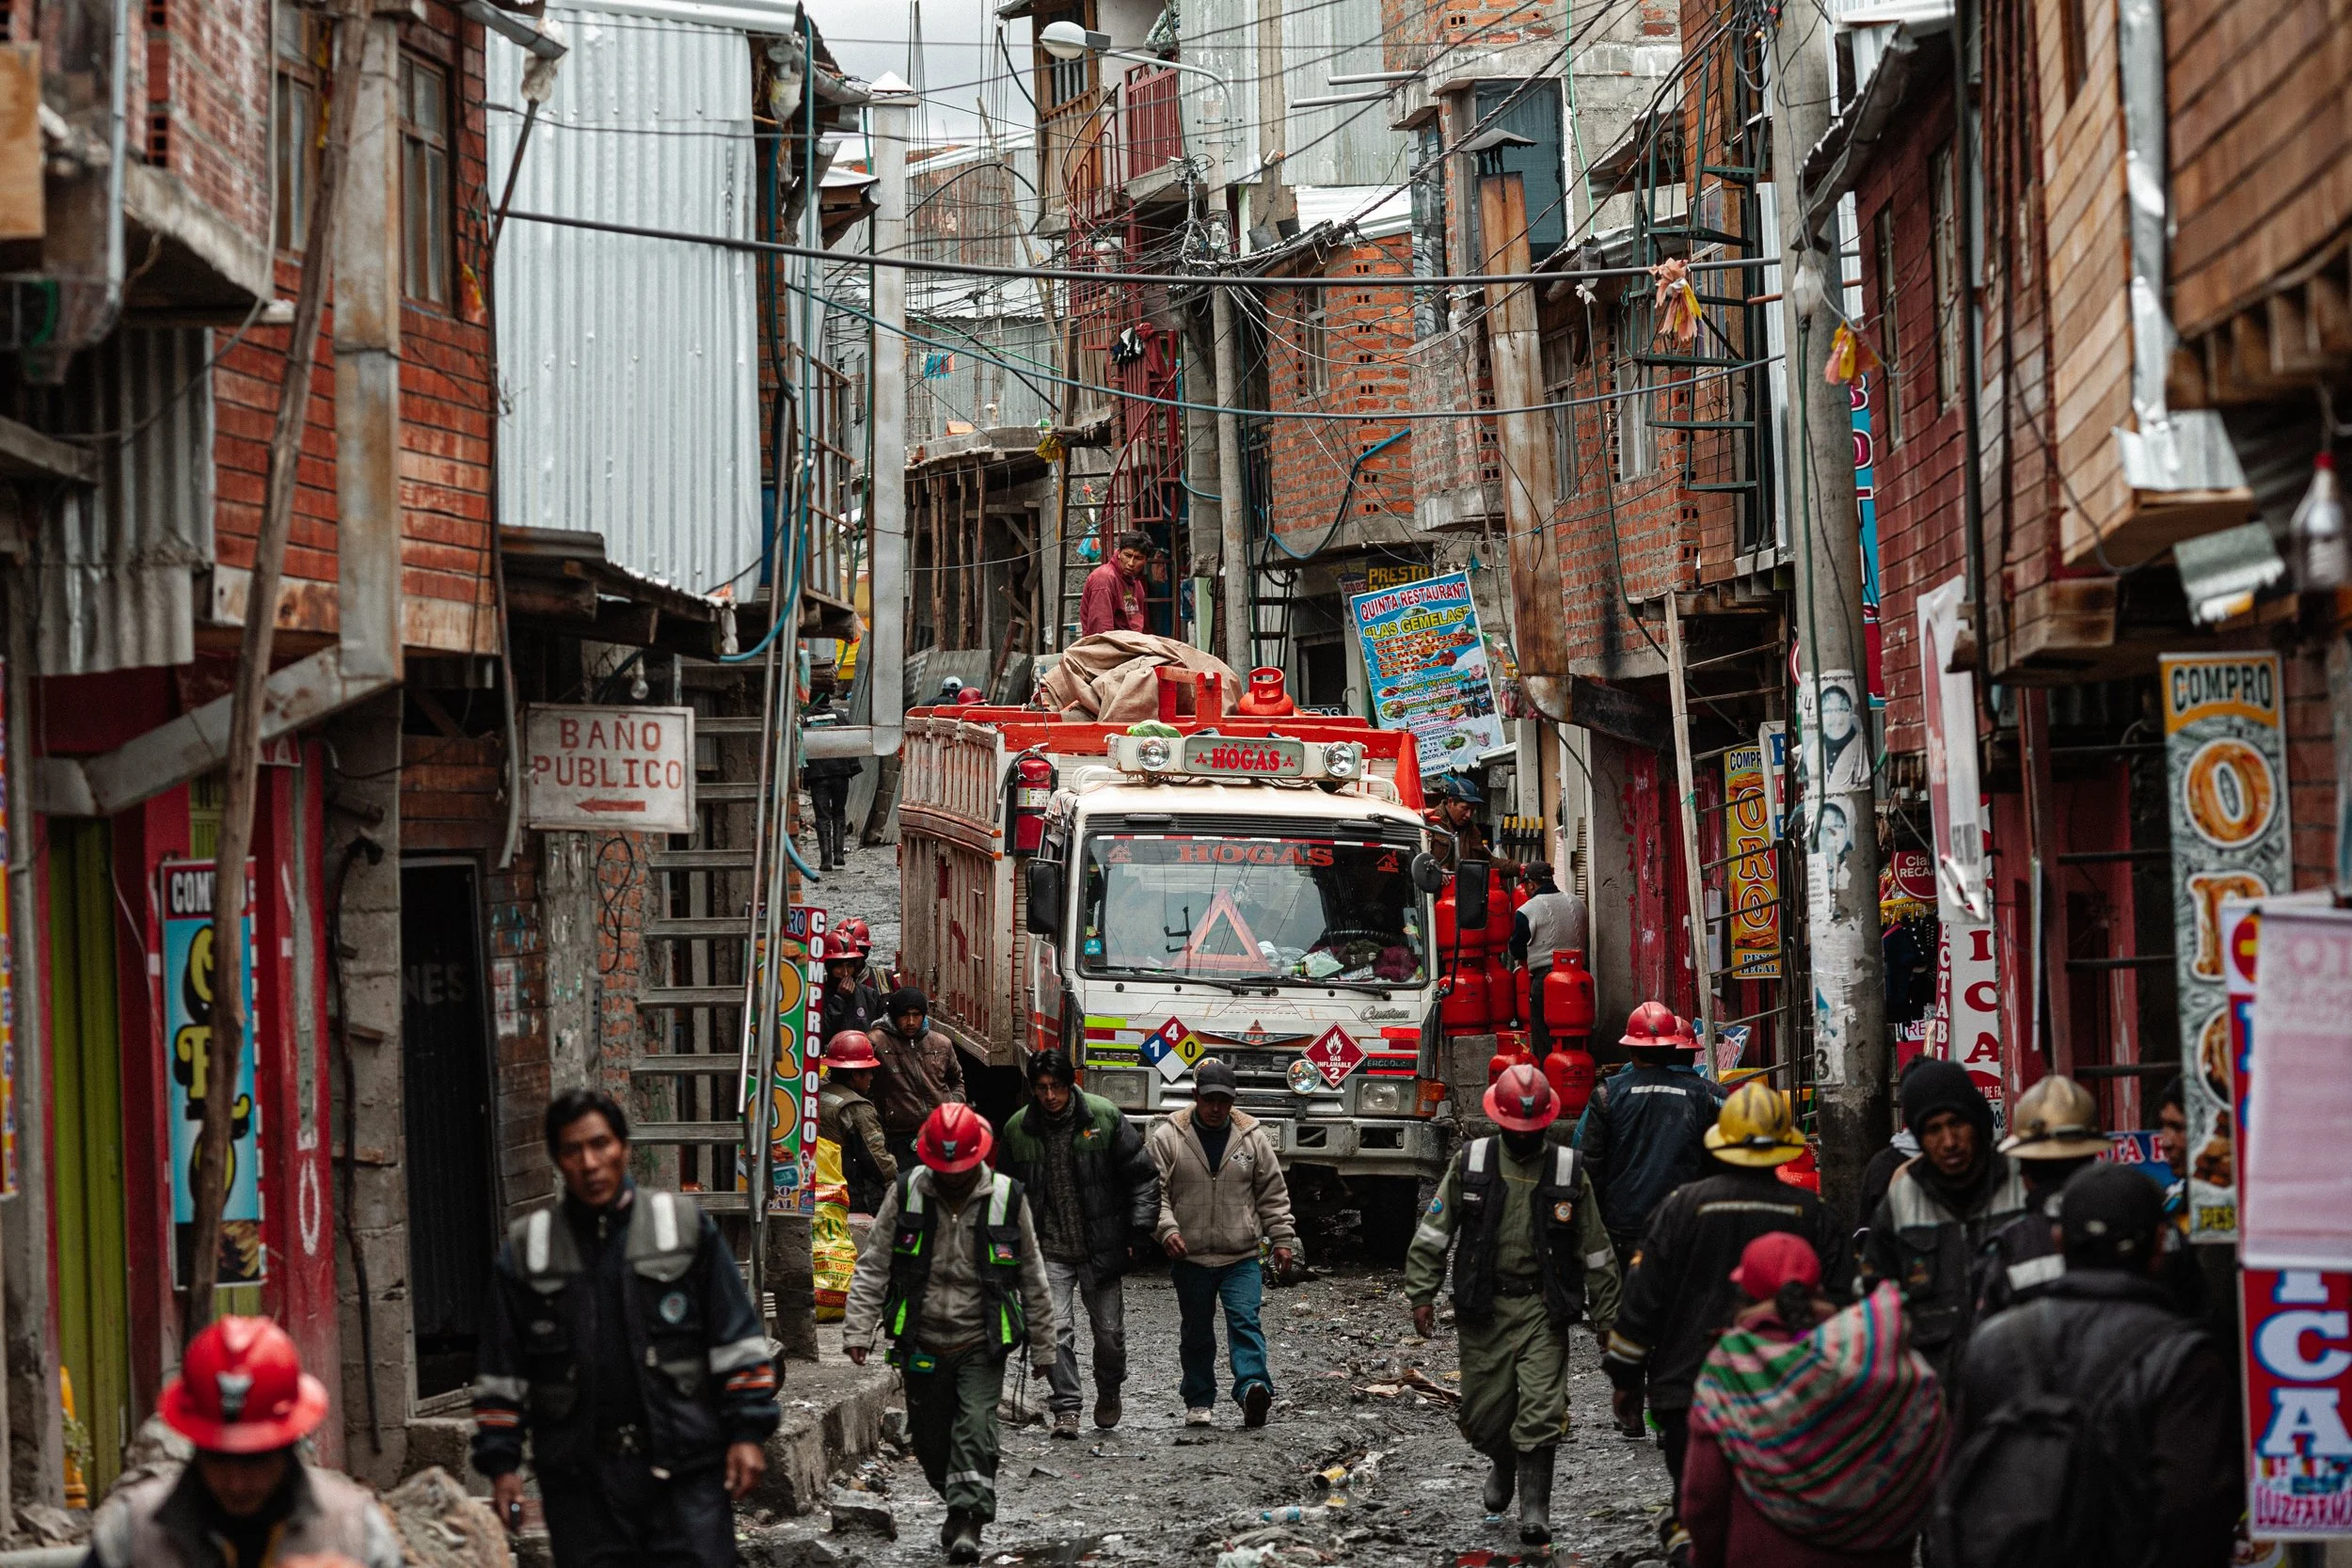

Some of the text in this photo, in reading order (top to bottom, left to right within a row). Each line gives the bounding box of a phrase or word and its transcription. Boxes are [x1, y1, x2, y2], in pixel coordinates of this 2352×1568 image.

[1369, 564, 1429, 584] PRESTO
[1360, 594, 1400, 621] QUINTA
[1400, 582, 1468, 606] RESTAURANT
[1377, 633, 1459, 656] DESAYUNO
[1378, 640, 1463, 663] ALMUERZO
[1381, 659, 1442, 677] EXTRAS
[1398, 683, 1424, 692] CALDO
[2172, 662, 2274, 715] COMPRO
[560, 713, 662, 752] BAÑO
[1211, 748, 1280, 771] HOGAS
[1729, 750, 1763, 771] COMPR
[532, 751, 682, 790] PÚBLICO
[1177, 844, 1334, 866] HOGAS
[1899, 867, 1934, 878] RECA
[1360, 1006, 1410, 1022] Custom
[802, 911, 826, 1144] COMPRO ORO
[1166, 1023, 1179, 1041] 4
[1094, 1052, 1141, 1062] TURBO
[1150, 1039, 1196, 1058] 1 0
[1328, 1068, 1341, 1080] 2
[1816, 1048, 1830, 1081] 3
